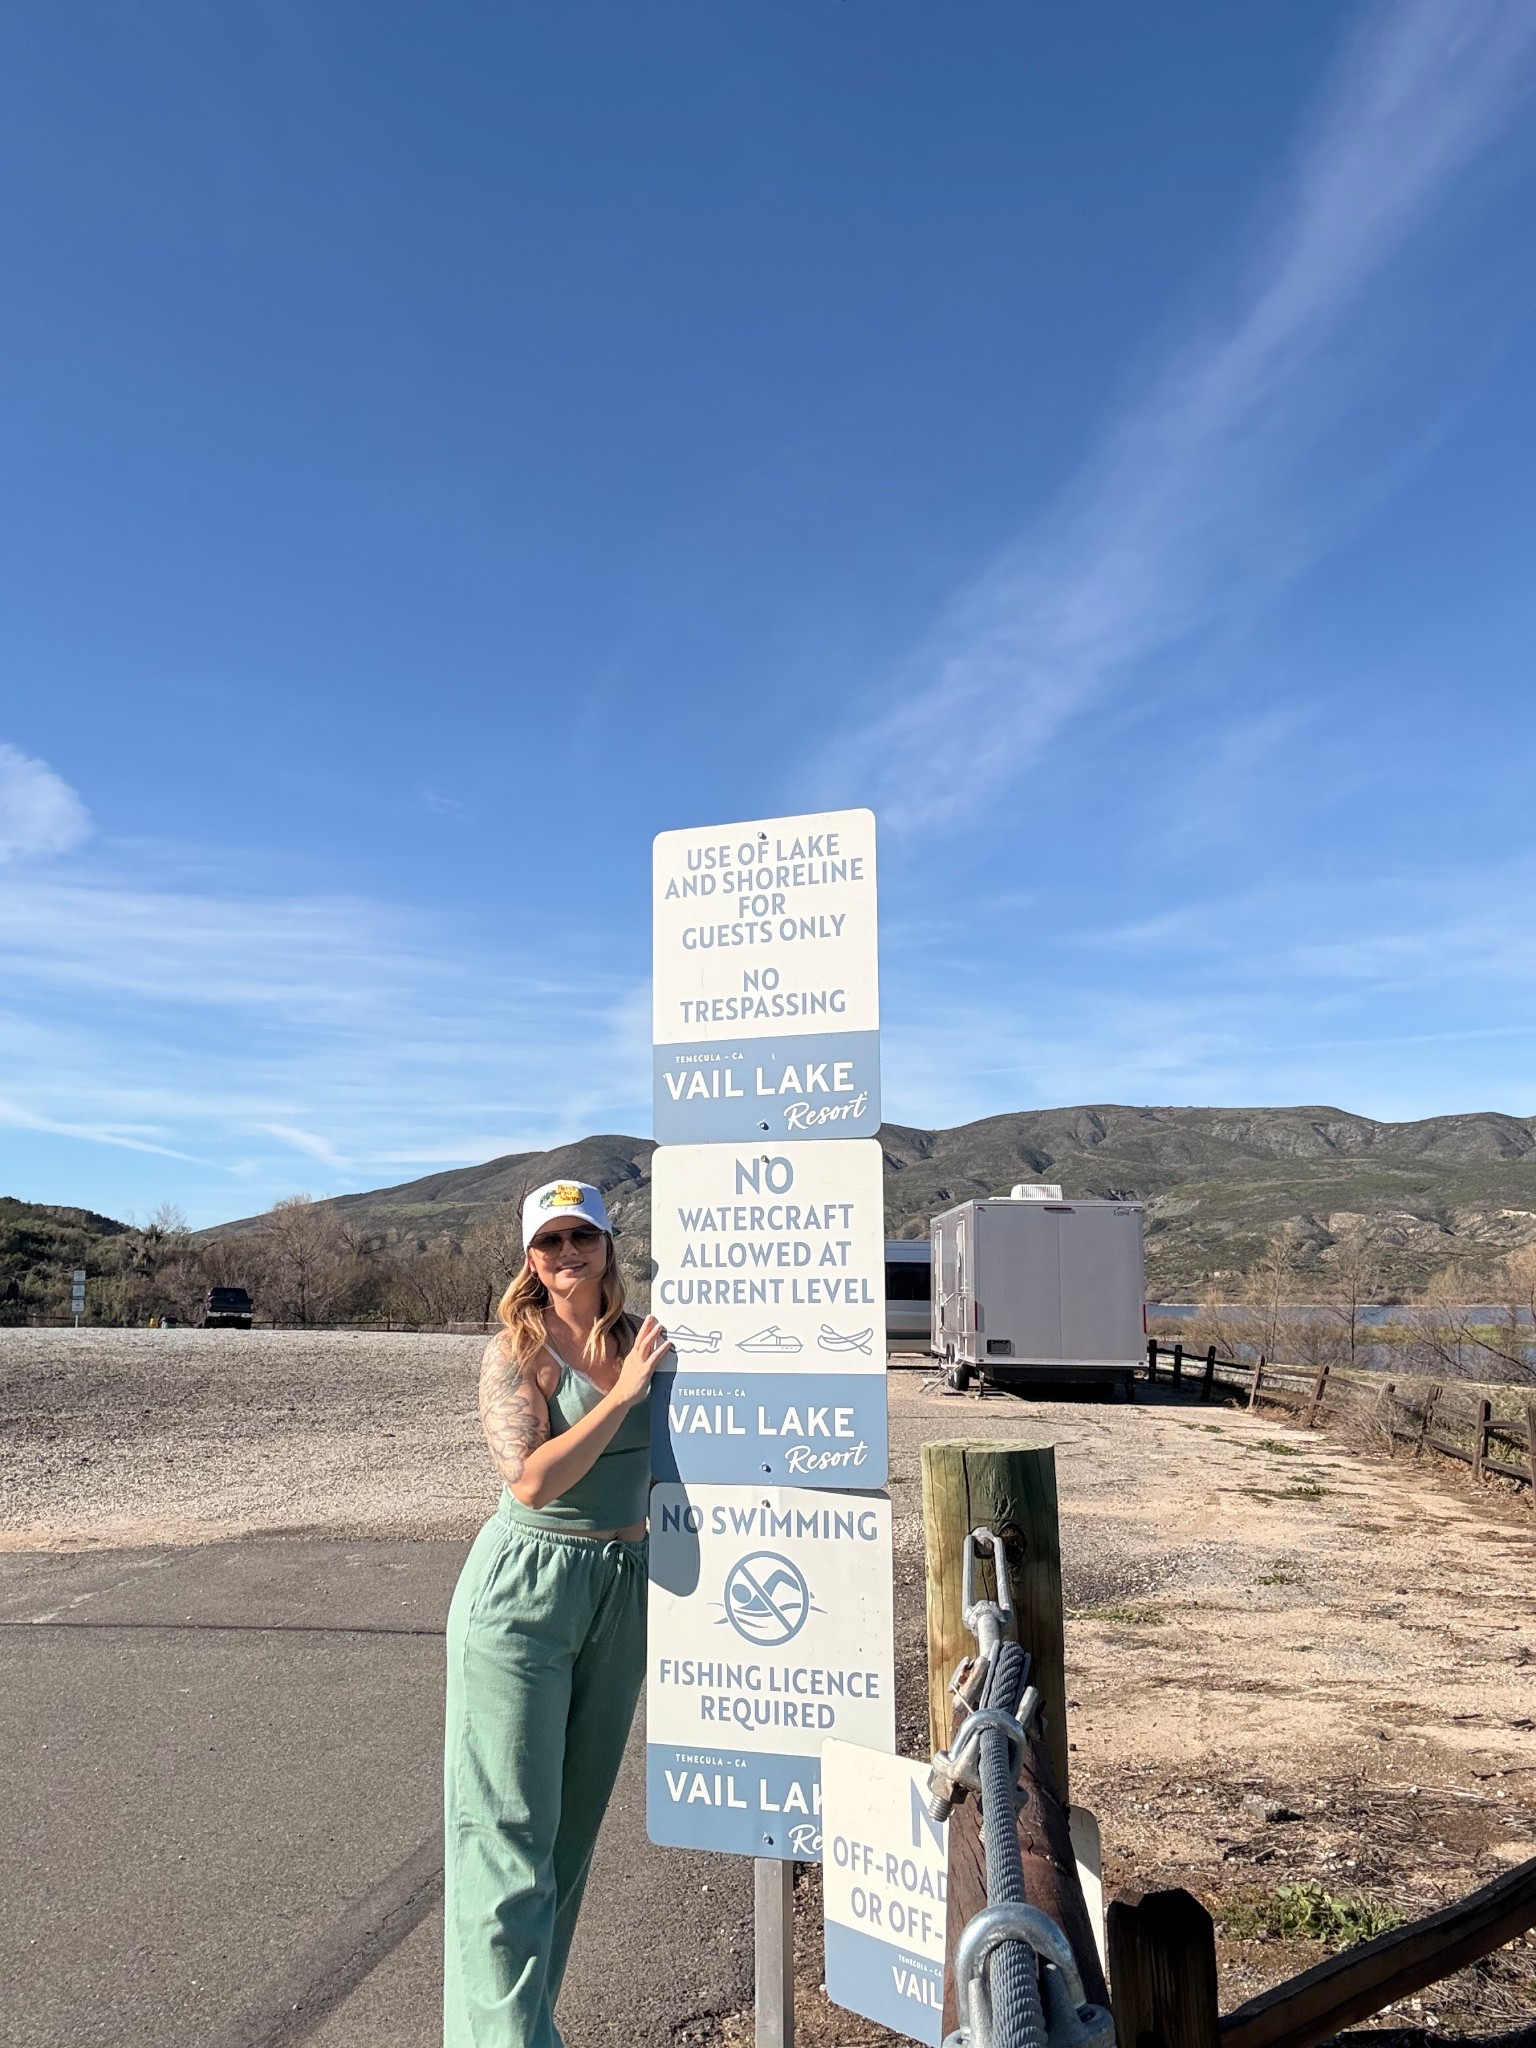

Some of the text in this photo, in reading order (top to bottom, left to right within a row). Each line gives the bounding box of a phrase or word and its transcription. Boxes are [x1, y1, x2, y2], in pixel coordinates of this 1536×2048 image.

[687, 833, 840, 870] USE OF LAKE
[665, 857, 864, 899] AND SHORELINE
[739, 892, 785, 918] FOR
[682, 914, 846, 950] GUESTS ONLY
[743, 968, 779, 992] NO
[680, 989, 846, 1024] TRESPASSING
[676, 1054, 721, 1064] TEMECULA
[732, 1052, 744, 1060] CA
[665, 1062, 854, 1100] VAIL LAKE
[783, 1094, 868, 1130] Resort
[736, 1156, 793, 1195] NO
[678, 1204, 854, 1231] WATERCRAFT
[681, 1241, 851, 1268] ALLOWED AT
[661, 1279, 874, 1305] CURRENT LEVEL
[678, 1388, 723, 1396] TEMECULA
[734, 1389, 746, 1397] CA
[669, 1404, 854, 1437] VAIL LAKE
[785, 1441, 868, 1473] Resort
[661, 1504, 877, 1541] NO SWIMMING
[660, 1659, 879, 1698] FISHING LICENCE
[701, 1695, 835, 1731] REQUIRED
[676, 1754, 723, 1765] TEMECULA
[735, 1759, 747, 1768] CA
[664, 1770, 822, 1816] VAIL LA
[911, 1776, 944, 1857] N
[851, 1887, 882, 1926] OR
[892, 1966, 943, 2011] VAIL
